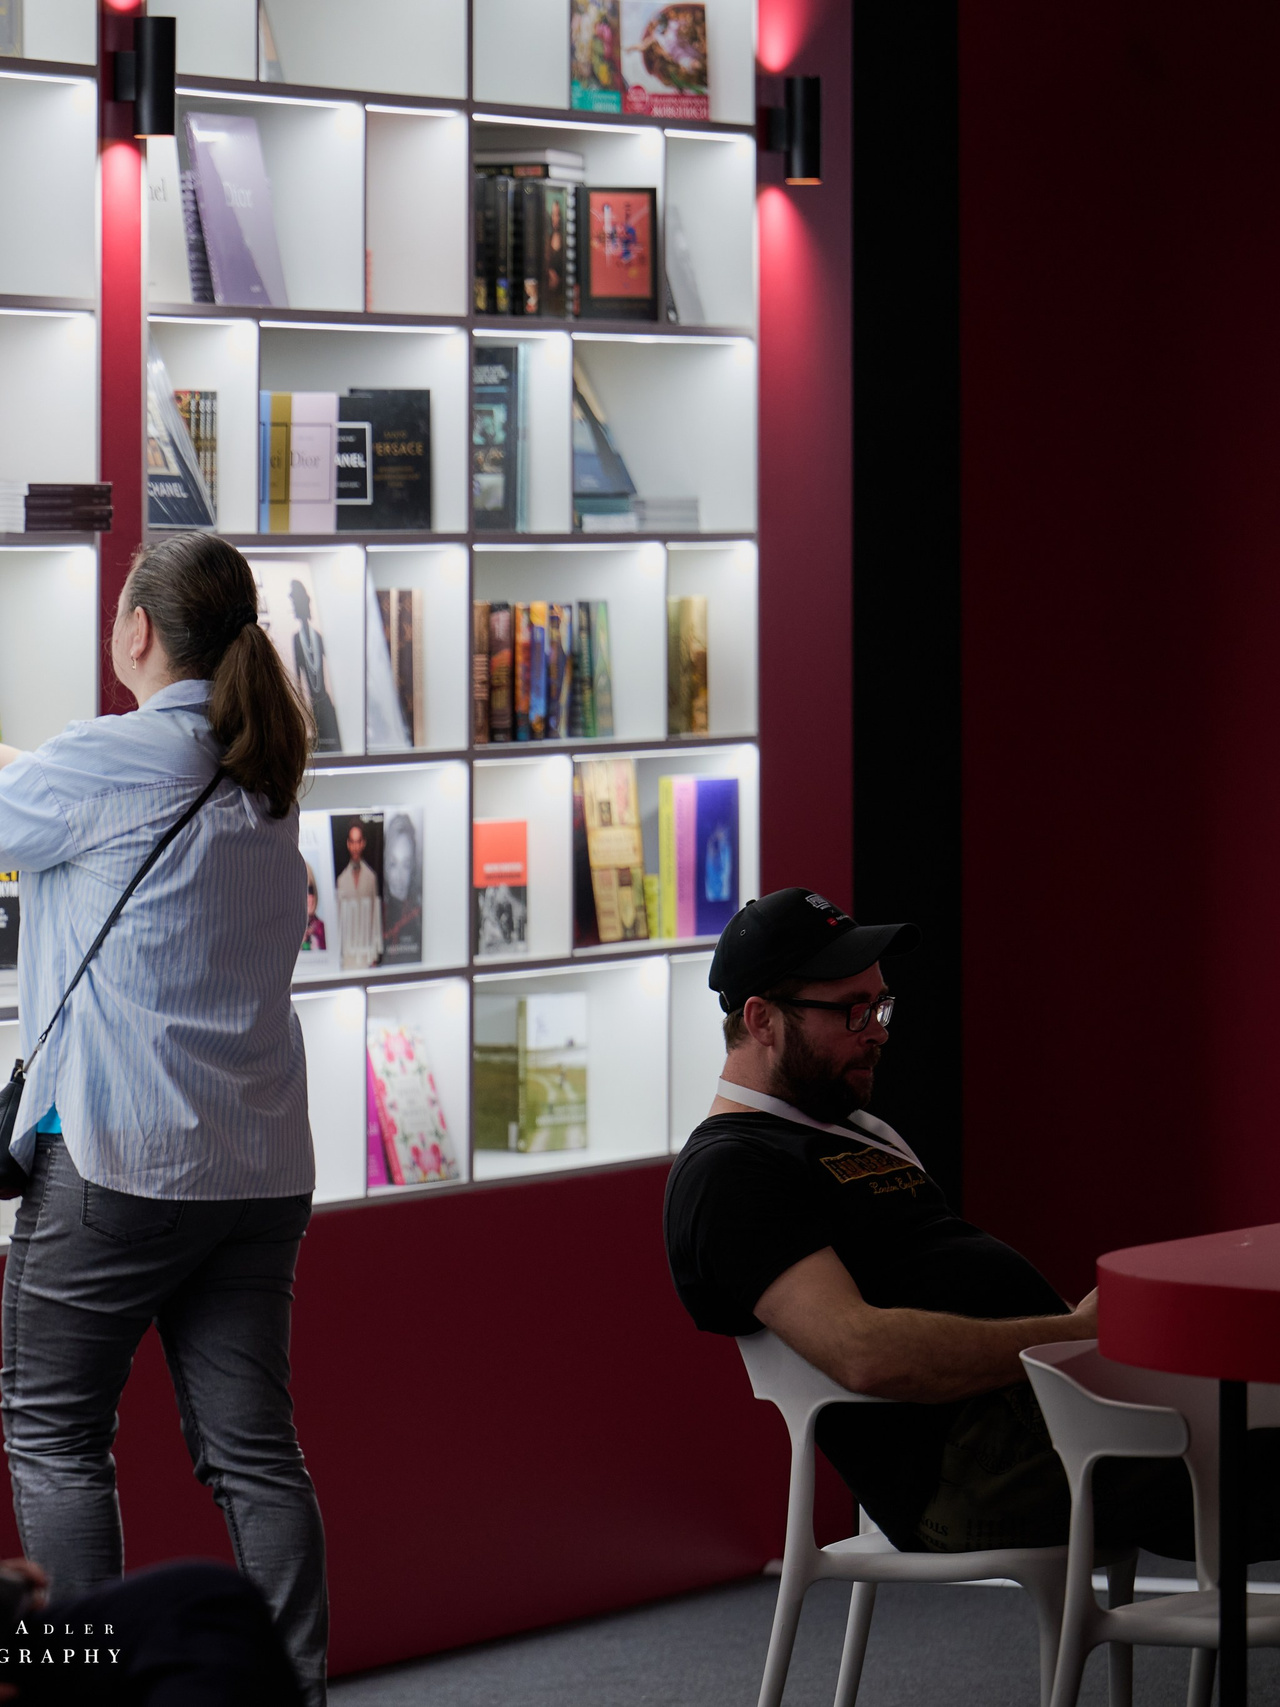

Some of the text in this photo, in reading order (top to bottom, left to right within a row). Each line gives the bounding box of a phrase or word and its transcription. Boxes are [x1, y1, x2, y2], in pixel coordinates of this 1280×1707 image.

[222, 181, 254, 209] Dior
[374, 442, 423, 456] ERSACE
[290, 452, 321, 469] Dior
[334, 453, 366, 468] ANEL
